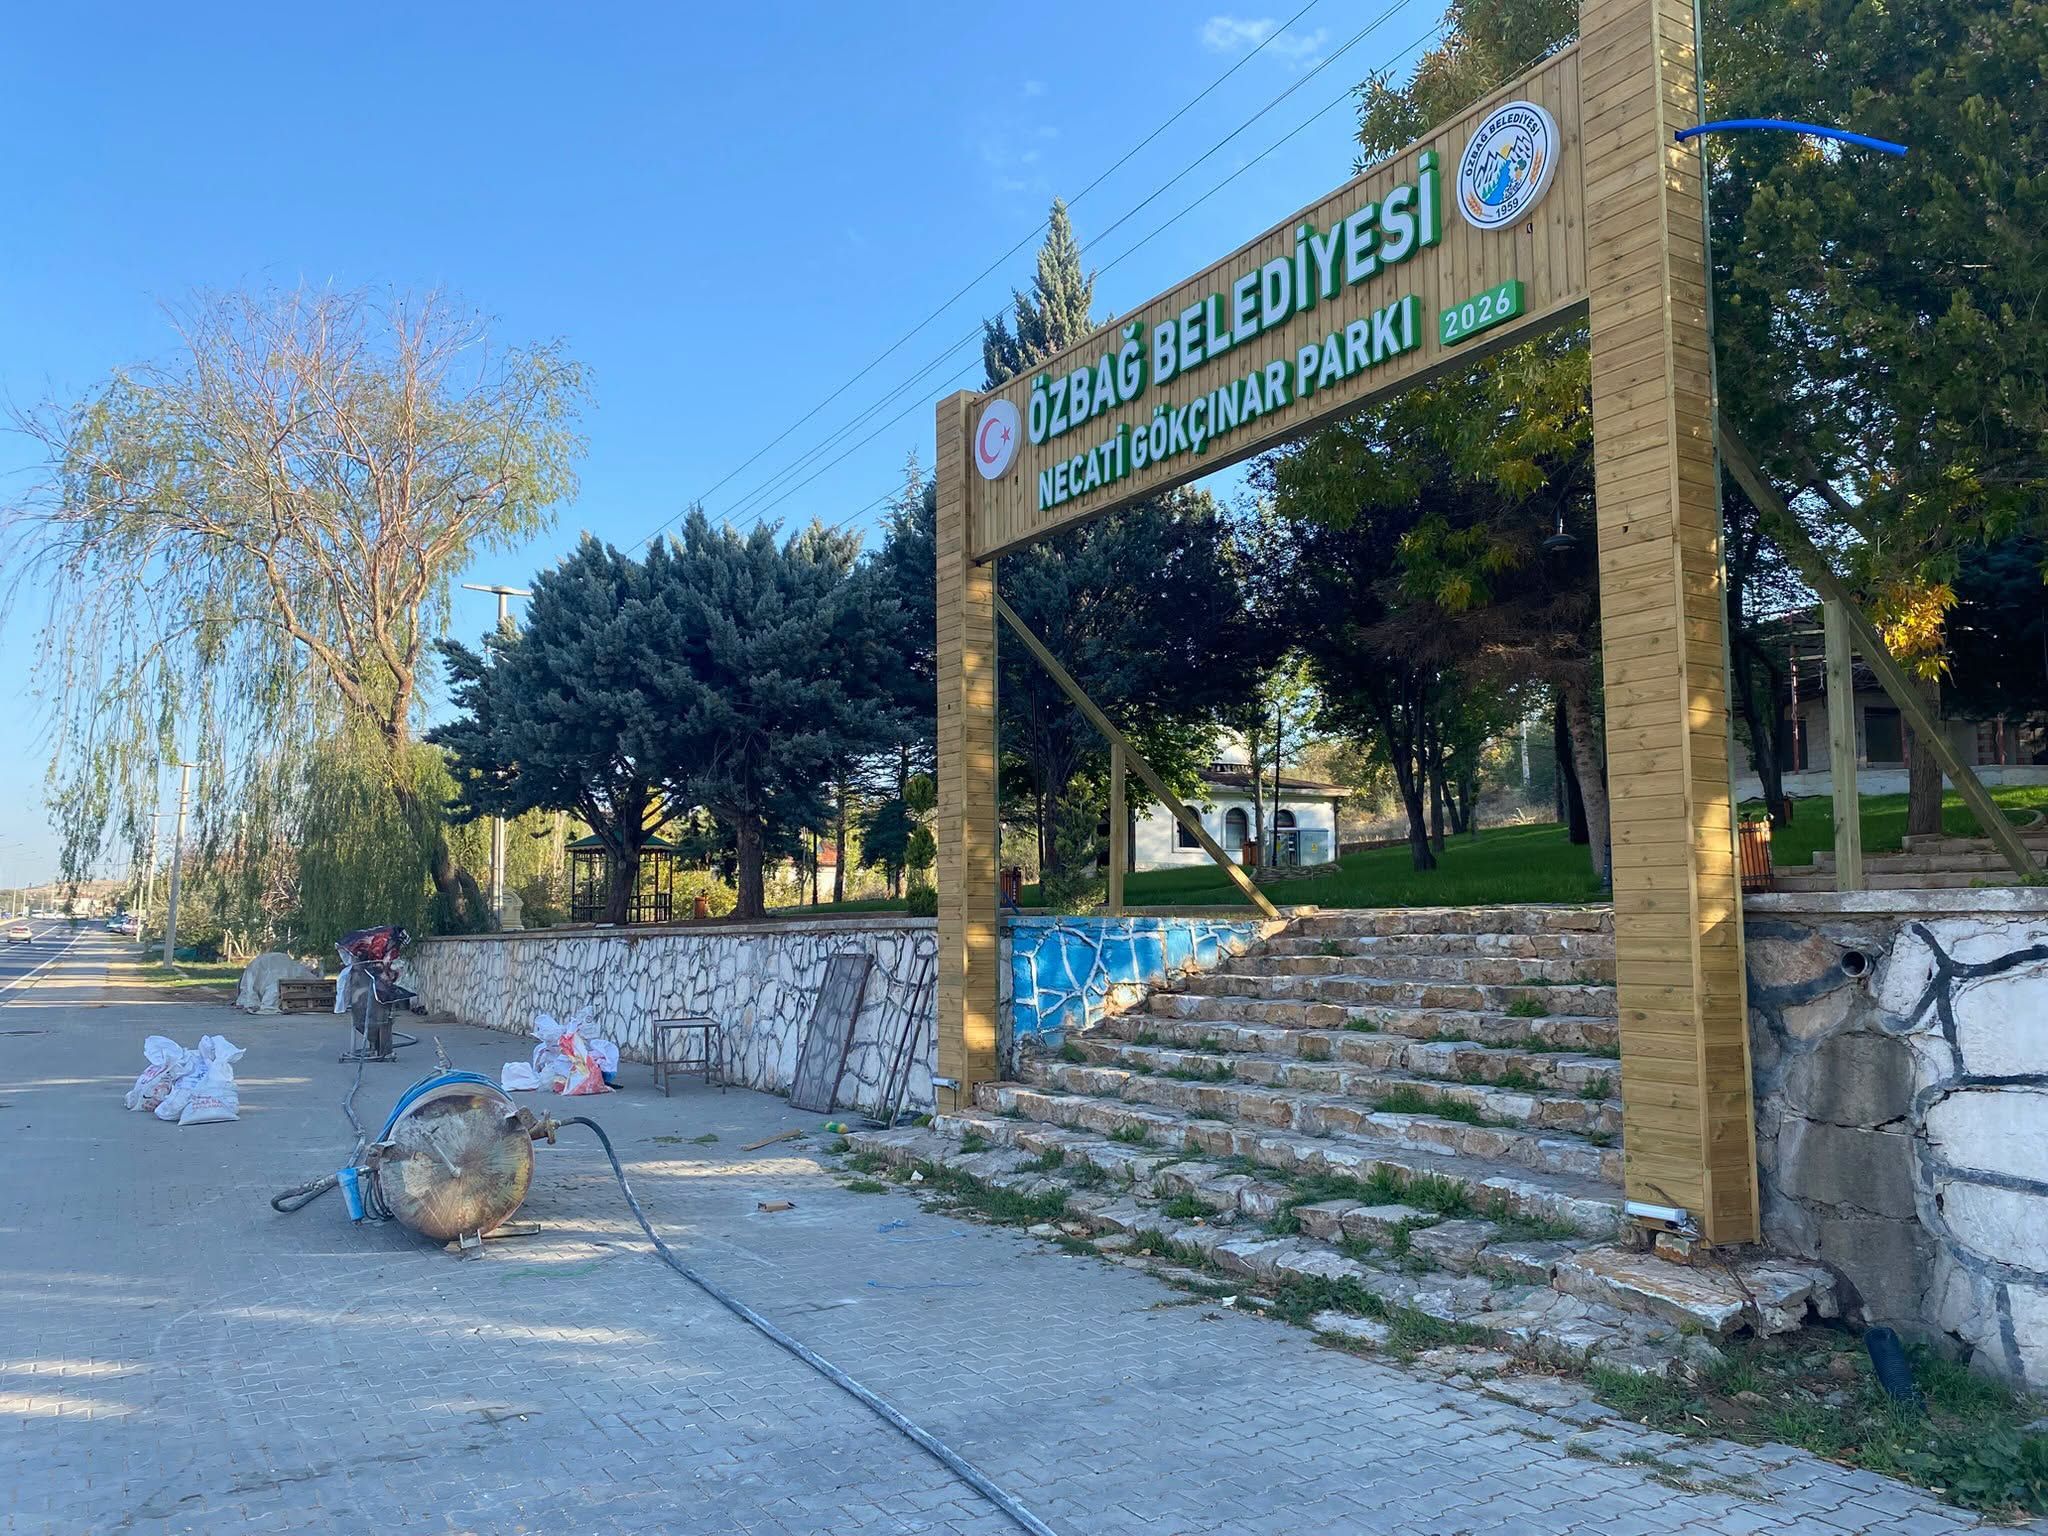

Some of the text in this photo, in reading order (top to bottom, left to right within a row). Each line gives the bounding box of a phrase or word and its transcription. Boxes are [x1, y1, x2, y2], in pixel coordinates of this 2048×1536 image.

[1465, 111, 1541, 177] ÖZBAĞ BELEDİYESİ
[1495, 197, 1519, 218] 1959
[1028, 150, 1437, 446] ÖZBAĞ BELEDİYESİ
[1444, 287, 1511, 339] 2026
[1037, 294, 1416, 511] NECATİ GÖKÇINAR PARKI
